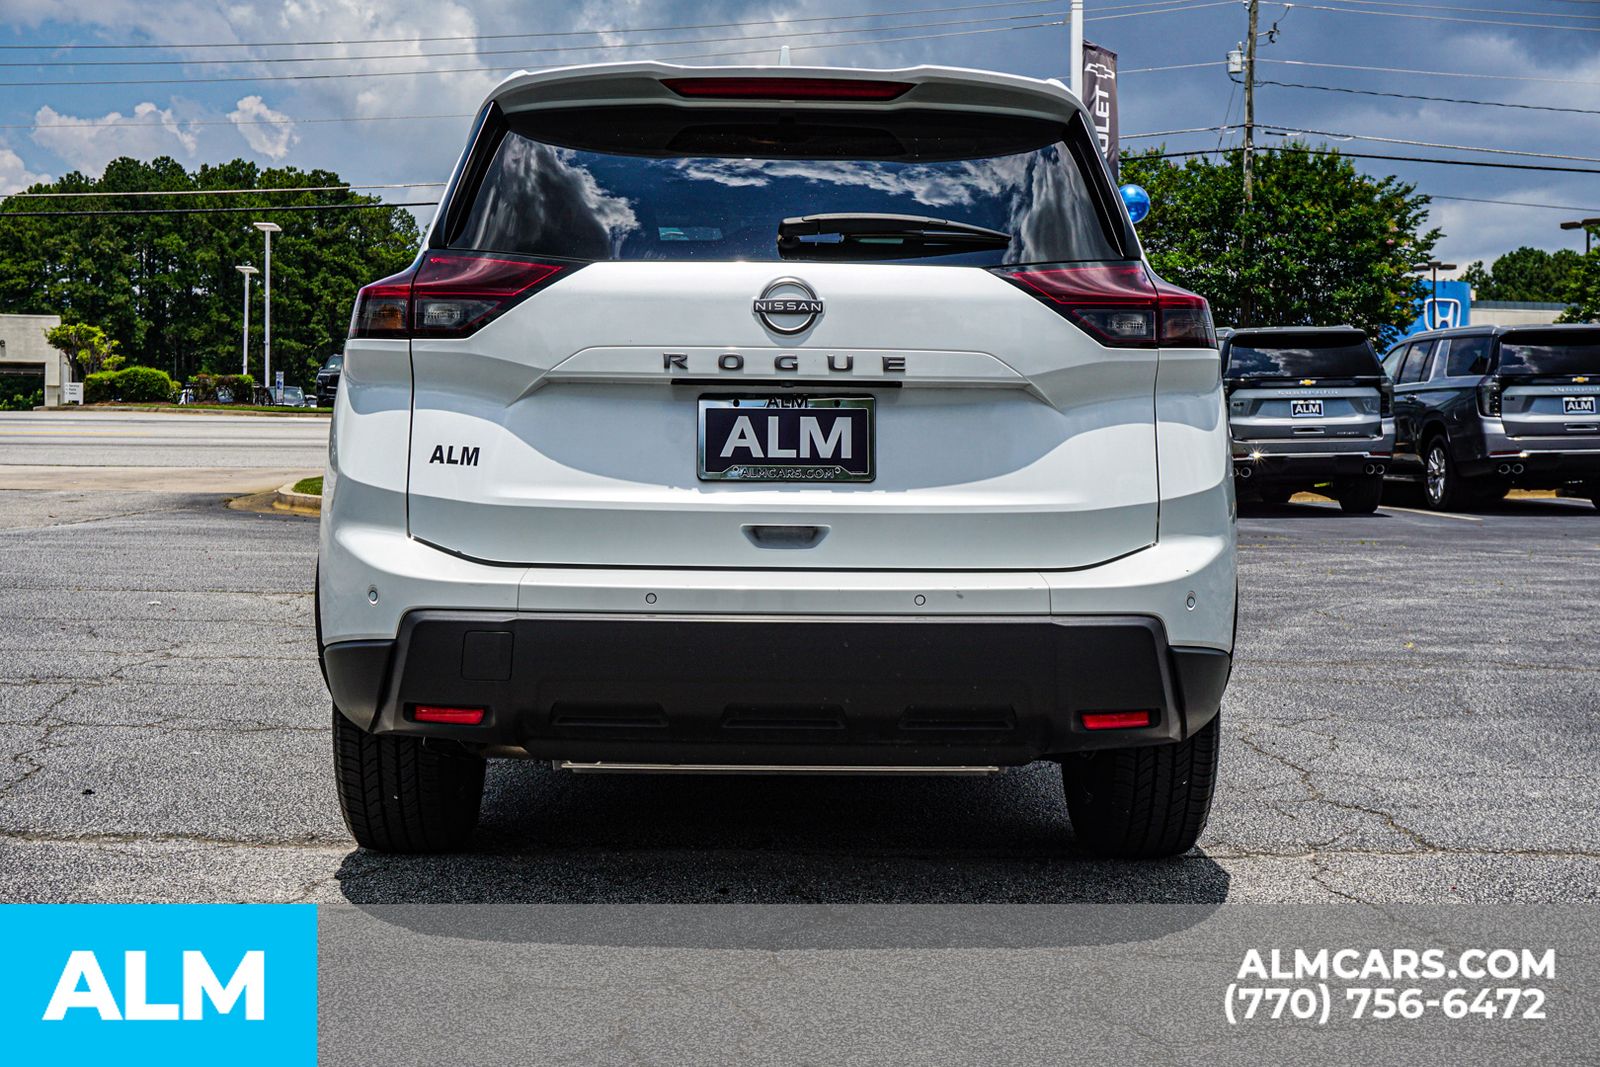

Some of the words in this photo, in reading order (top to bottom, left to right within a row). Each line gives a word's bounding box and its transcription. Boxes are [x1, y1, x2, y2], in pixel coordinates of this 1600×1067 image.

[1095, 85, 1110, 159] OLET
[755, 301, 822, 312] NISSAN
[663, 353, 907, 372] ROGUE
[766, 395, 809, 408] ALM
[1567, 401, 1592, 411] ALM
[1294, 404, 1320, 414] ALM
[720, 415, 852, 459] ALM
[429, 445, 480, 467] ALM
[739, 467, 836, 479] ALMCARS.COM
